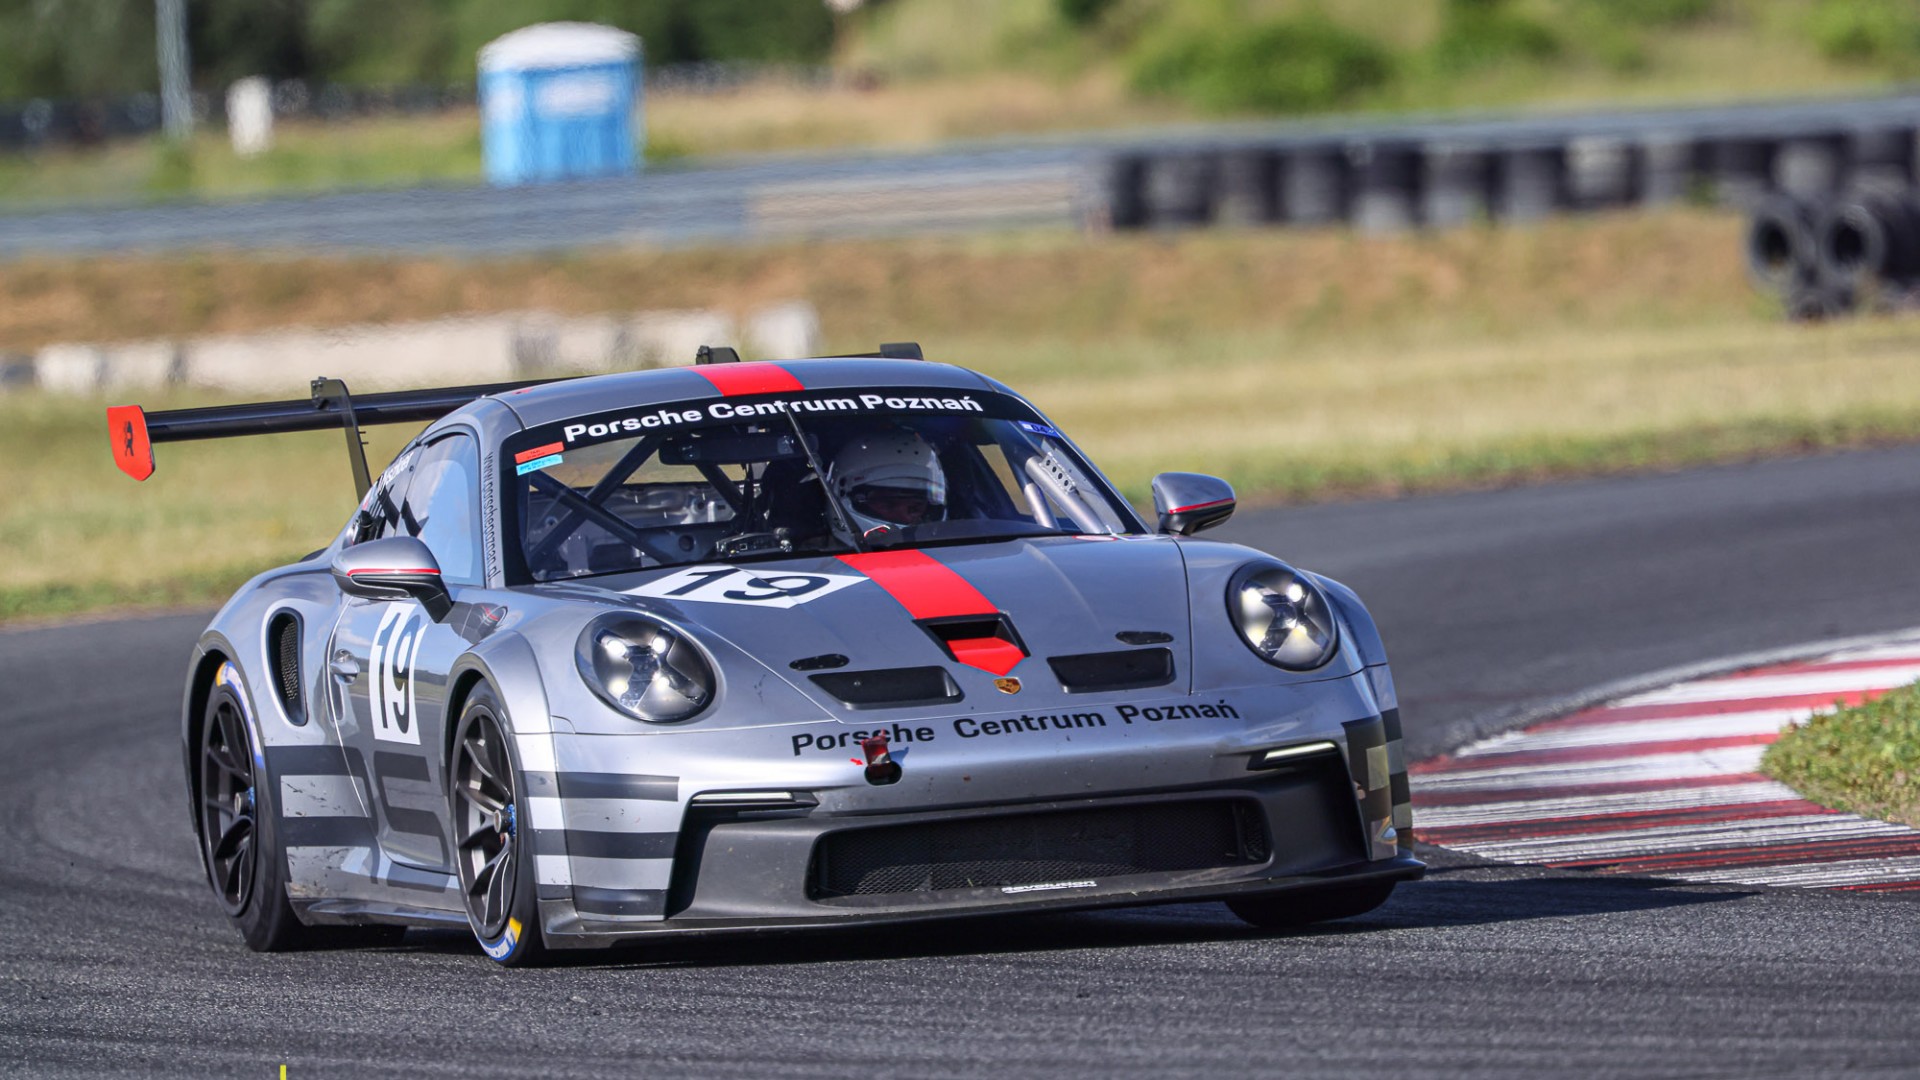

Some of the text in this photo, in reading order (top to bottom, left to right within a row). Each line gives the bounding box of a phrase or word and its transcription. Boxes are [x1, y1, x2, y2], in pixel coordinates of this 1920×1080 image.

[563, 394, 984, 443] Porsche Centrum Poznań
[483, 451, 501, 581] www.porschepoznan.pl
[663, 568, 831, 601] 19
[377, 612, 421, 735] 19
[953, 712, 1106, 740] Centrum
[1115, 699, 1241, 725] Poznań
